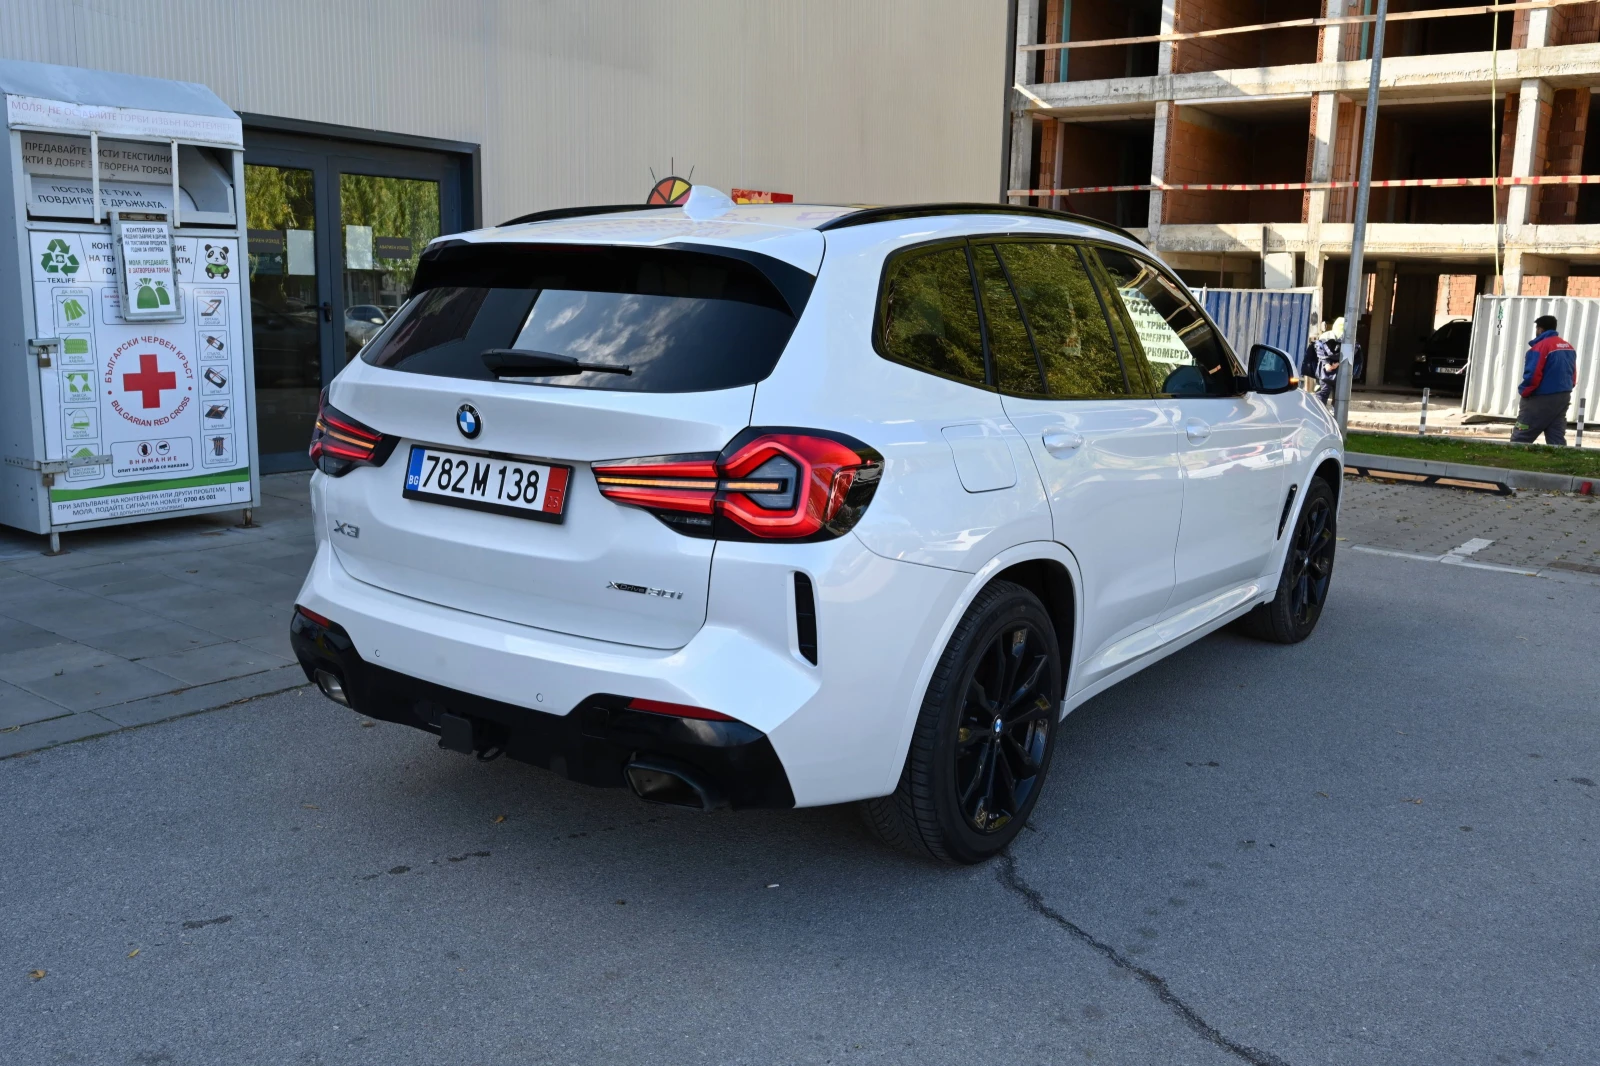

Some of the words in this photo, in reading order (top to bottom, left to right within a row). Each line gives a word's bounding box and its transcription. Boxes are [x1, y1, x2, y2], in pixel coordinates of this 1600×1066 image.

[48, 106, 61, 115] НЕ
[119, 113, 149, 124] ТОРБИ
[152, 117, 180, 127] ИЗВЪН
[25, 142, 86, 155] ПРЕДАВАЙТЕ
[90, 147, 119, 158] ИСТИ
[122, 151, 172, 162] ТЕКСТИЛНИ
[47, 157, 52, 165] В
[55, 158, 86, 168] ДОБРЕ
[88, 161, 139, 173] ЗТВОРЕНА
[142, 165, 172, 175] ТОРБА!
[51, 186, 112, 196] ПОСТАВТЕ
[112, 189, 132, 197] ТУК
[38, 195, 108, 206] ПОВДИГНЕЕ
[111, 199, 167, 209] ДРЪЖКАТА.
[89, 254, 100, 262] НА
[105, 337, 139, 383] БЪЛГАРСКИ
[141, 336, 177, 352] ЧЕРВЕН
[175, 351, 194, 380] КРЪСТ
[111, 400, 152, 426] BULGARIAN
[153, 416, 170, 426] RED
[170, 396, 190, 420] CROSS
[129, 456, 177, 465] ВНИМАНИЕ
[139, 464, 160, 472] кражба
[409, 474, 420, 485] BG
[422, 455, 469, 493] 782
[497, 466, 540, 503] 138
[73, 499, 109, 508] ЗАПЪЛВАНЕ
[120, 494, 159, 503] КОНТЕЙНЕРА
[174, 490, 193, 498] ДРУГИ
[193, 486, 226, 495] ПРОБЛЕМИ,
[95, 504, 124, 513] ПОДАЙТЕ
[125, 501, 149, 510] СИГНАЛ
[333, 520, 360, 539] X3
